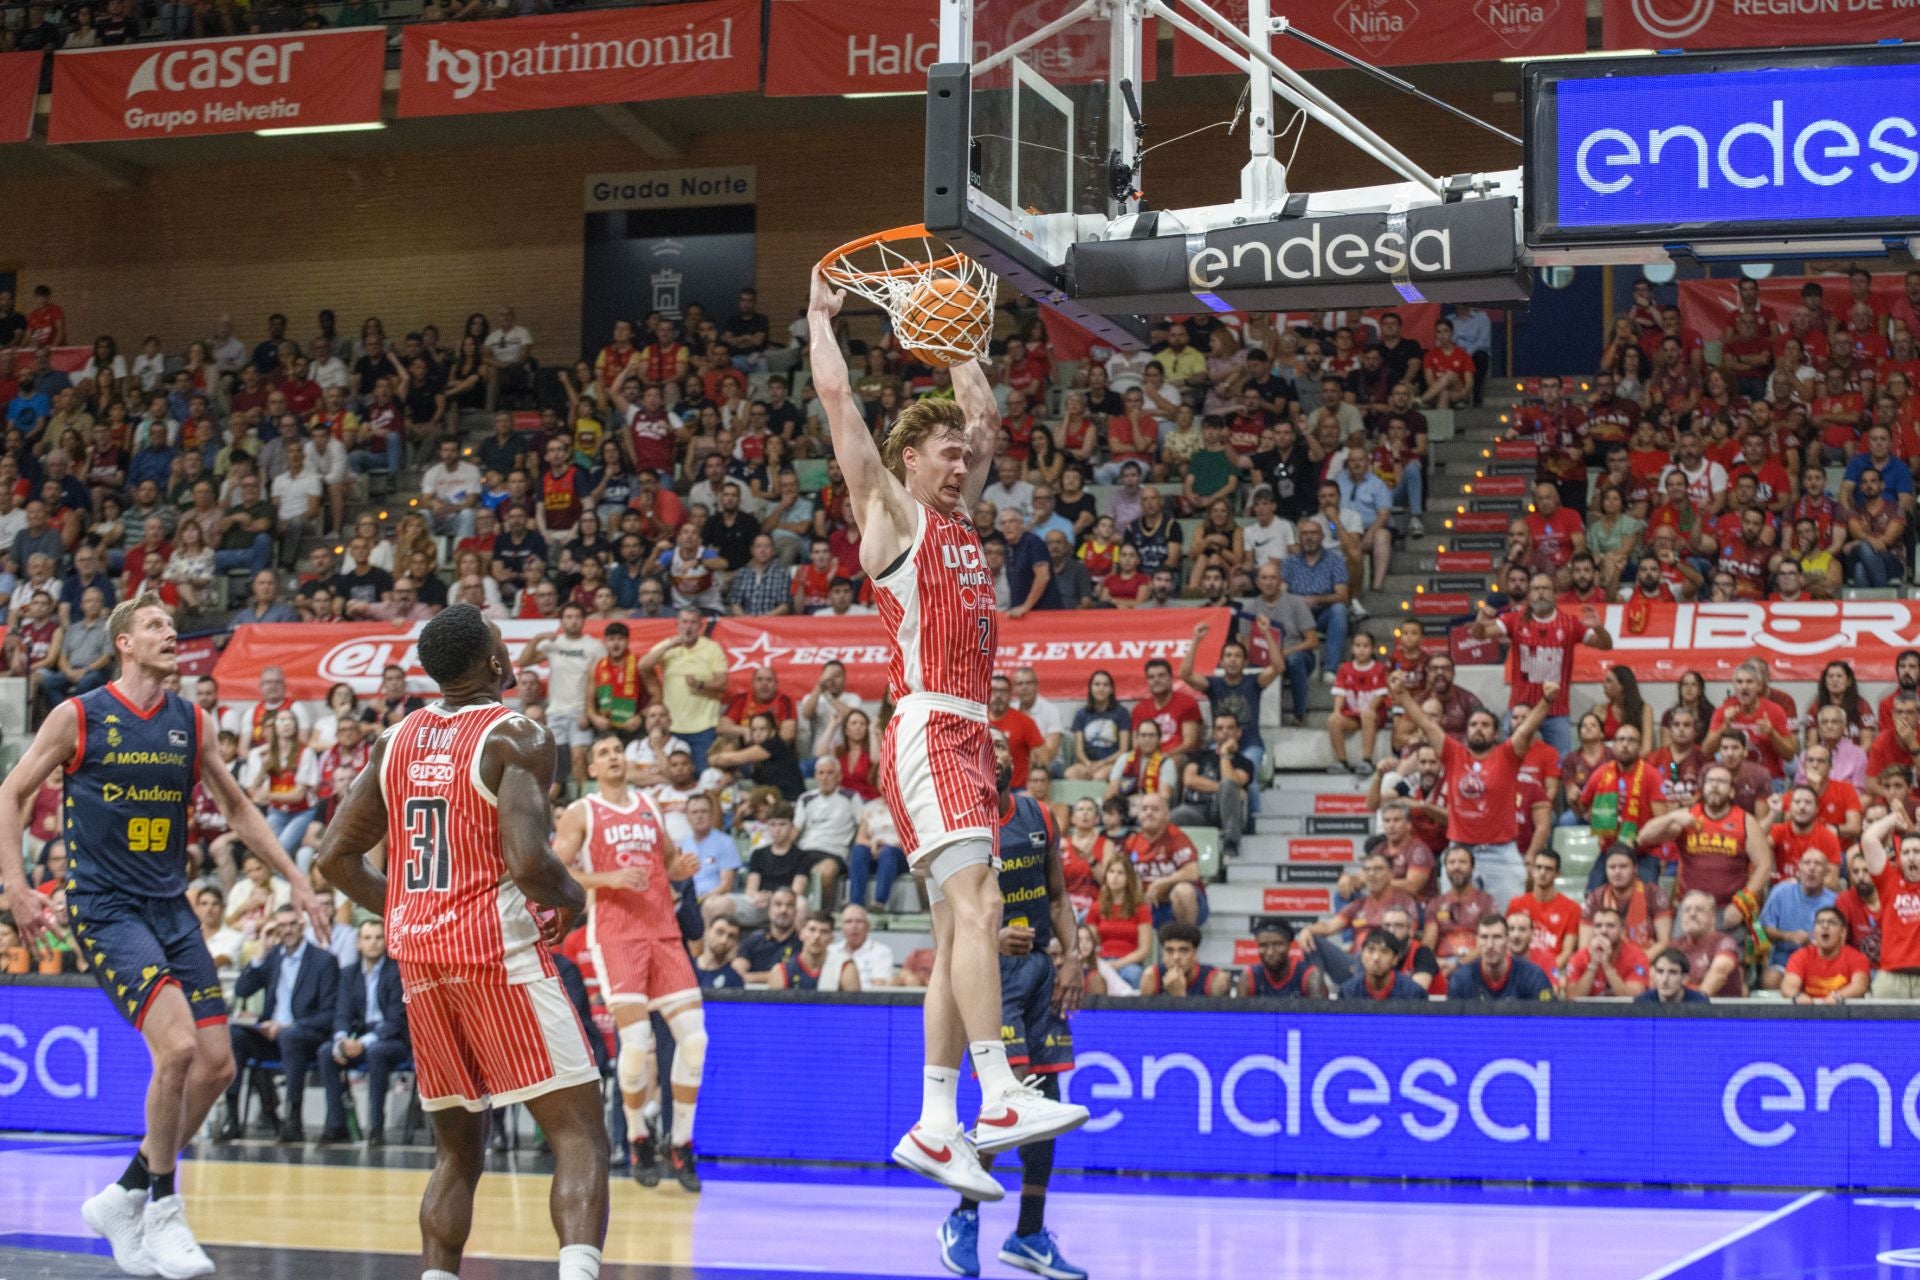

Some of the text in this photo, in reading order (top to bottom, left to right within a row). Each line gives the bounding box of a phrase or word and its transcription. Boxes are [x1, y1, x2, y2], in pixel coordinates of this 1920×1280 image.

[1349, 12, 1404, 34] Niña
[1489, 5, 1544, 25] Niña
[161, 42, 304, 91] caser
[481, 18, 734, 92] patrimonial
[124, 97, 302, 132] Grupo Helvetia
[592, 176, 749, 201] Grada Norte
[1189, 222, 1451, 288] endesa
[127, 817, 172, 853] 99
[404, 796, 451, 893] 31
[604, 823, 657, 845] UCAM
[1686, 832, 1738, 857] UCAM
[1060, 1030, 1551, 1143] endesa
